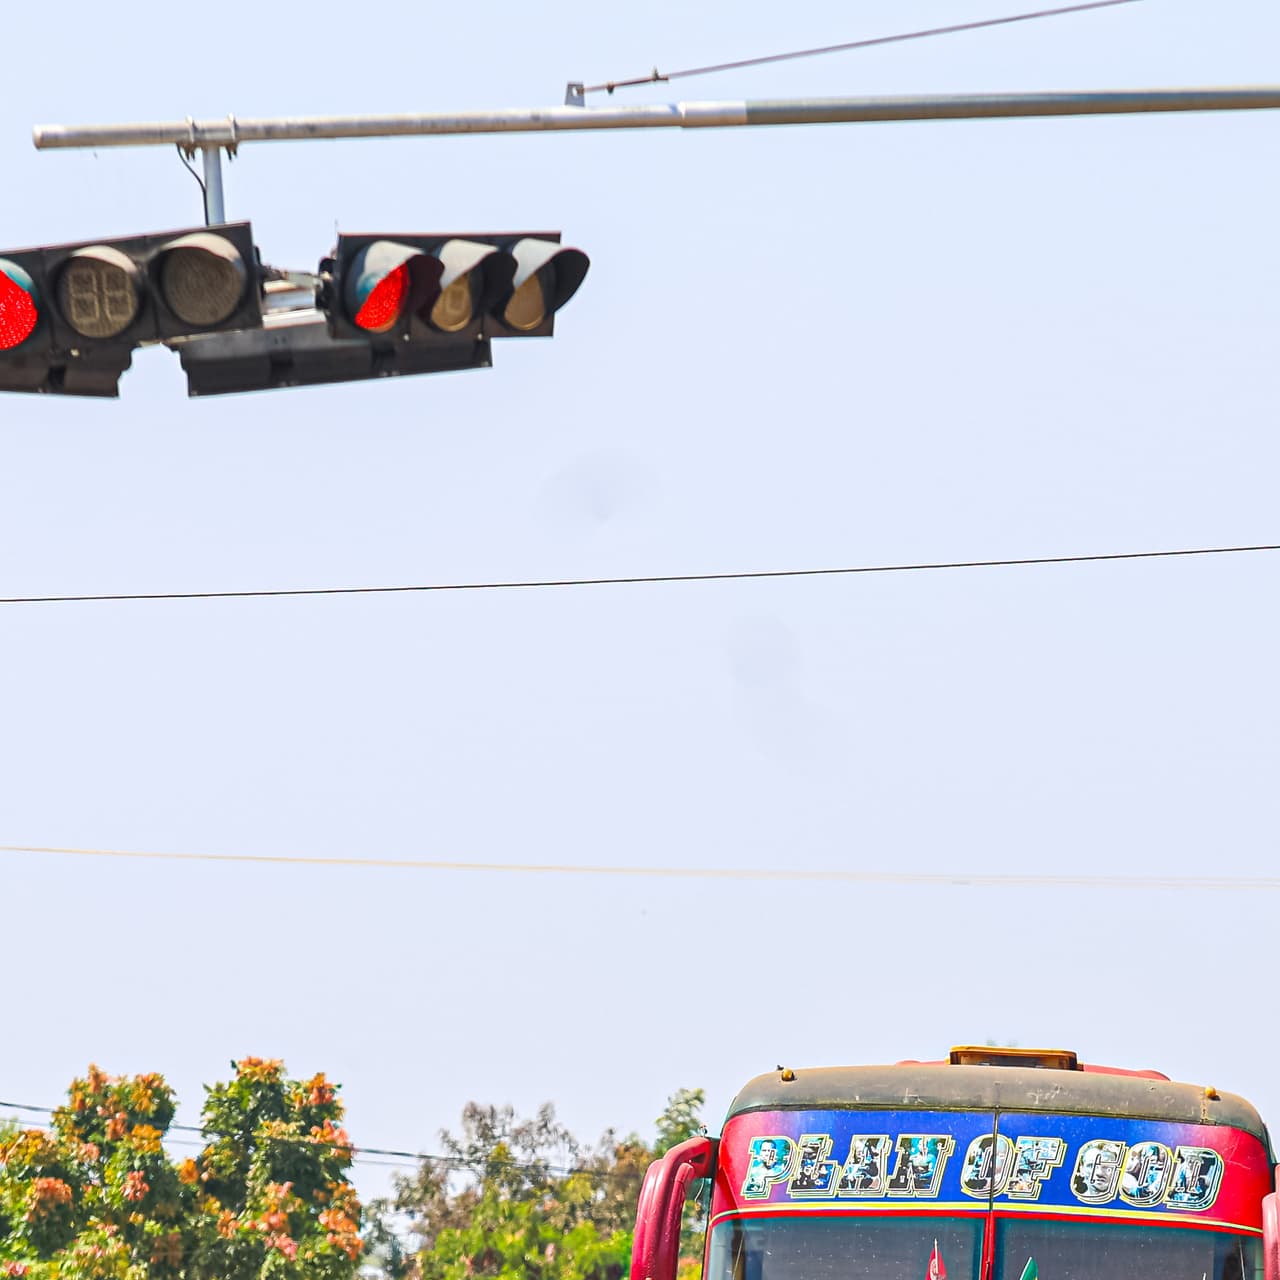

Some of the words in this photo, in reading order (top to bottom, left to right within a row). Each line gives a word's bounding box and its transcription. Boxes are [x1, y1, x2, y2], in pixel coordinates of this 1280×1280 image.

[741, 1134, 955, 1199] PLAN
[960, 1133, 1068, 1200] OF
[1070, 1139, 1224, 1212] GOD
